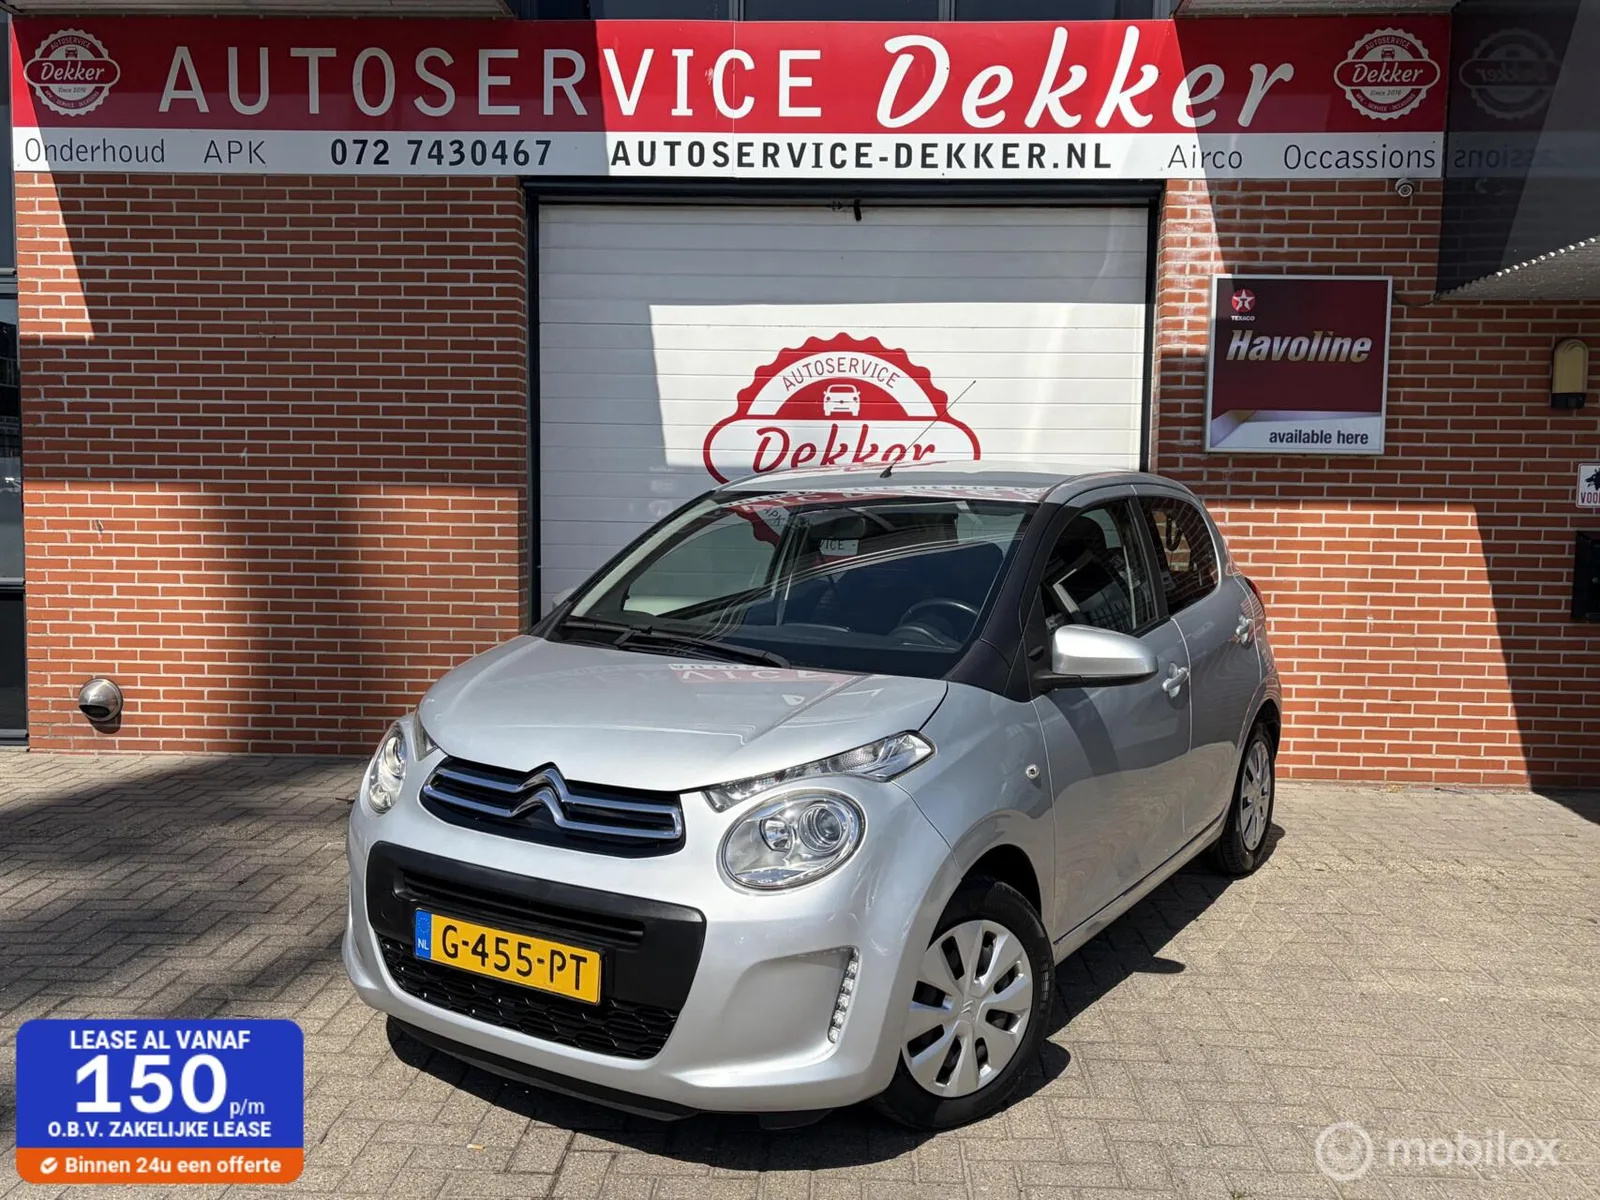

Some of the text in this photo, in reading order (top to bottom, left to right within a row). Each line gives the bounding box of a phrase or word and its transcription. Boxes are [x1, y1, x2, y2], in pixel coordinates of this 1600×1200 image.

[50, 36, 93, 50] AUTOSERVICE
[1365, 36, 1411, 51] AUTOSERVICE
[41, 61, 105, 80] Dekker
[158, 26, 1294, 129] AUTOSERVICE Dekker
[1352, 62, 1423, 83] Dekker
[24, 138, 165, 164] Onderhoud
[203, 139, 267, 165] APK
[331, 138, 552, 166] 072 7430467
[611, 140, 1111, 169] AUTOSERVICE-DEKKER.NL
[1168, 144, 1243, 170] Airco
[1284, 144, 1436, 171] Occassions
[1226, 329, 1373, 363] Havoline
[782, 357, 900, 392] AUTOSERVICE
[1269, 429, 1369, 445] available here
[1580, 492, 1600, 504] VOO
[417, 925, 588, 990] NL G-455-PT
